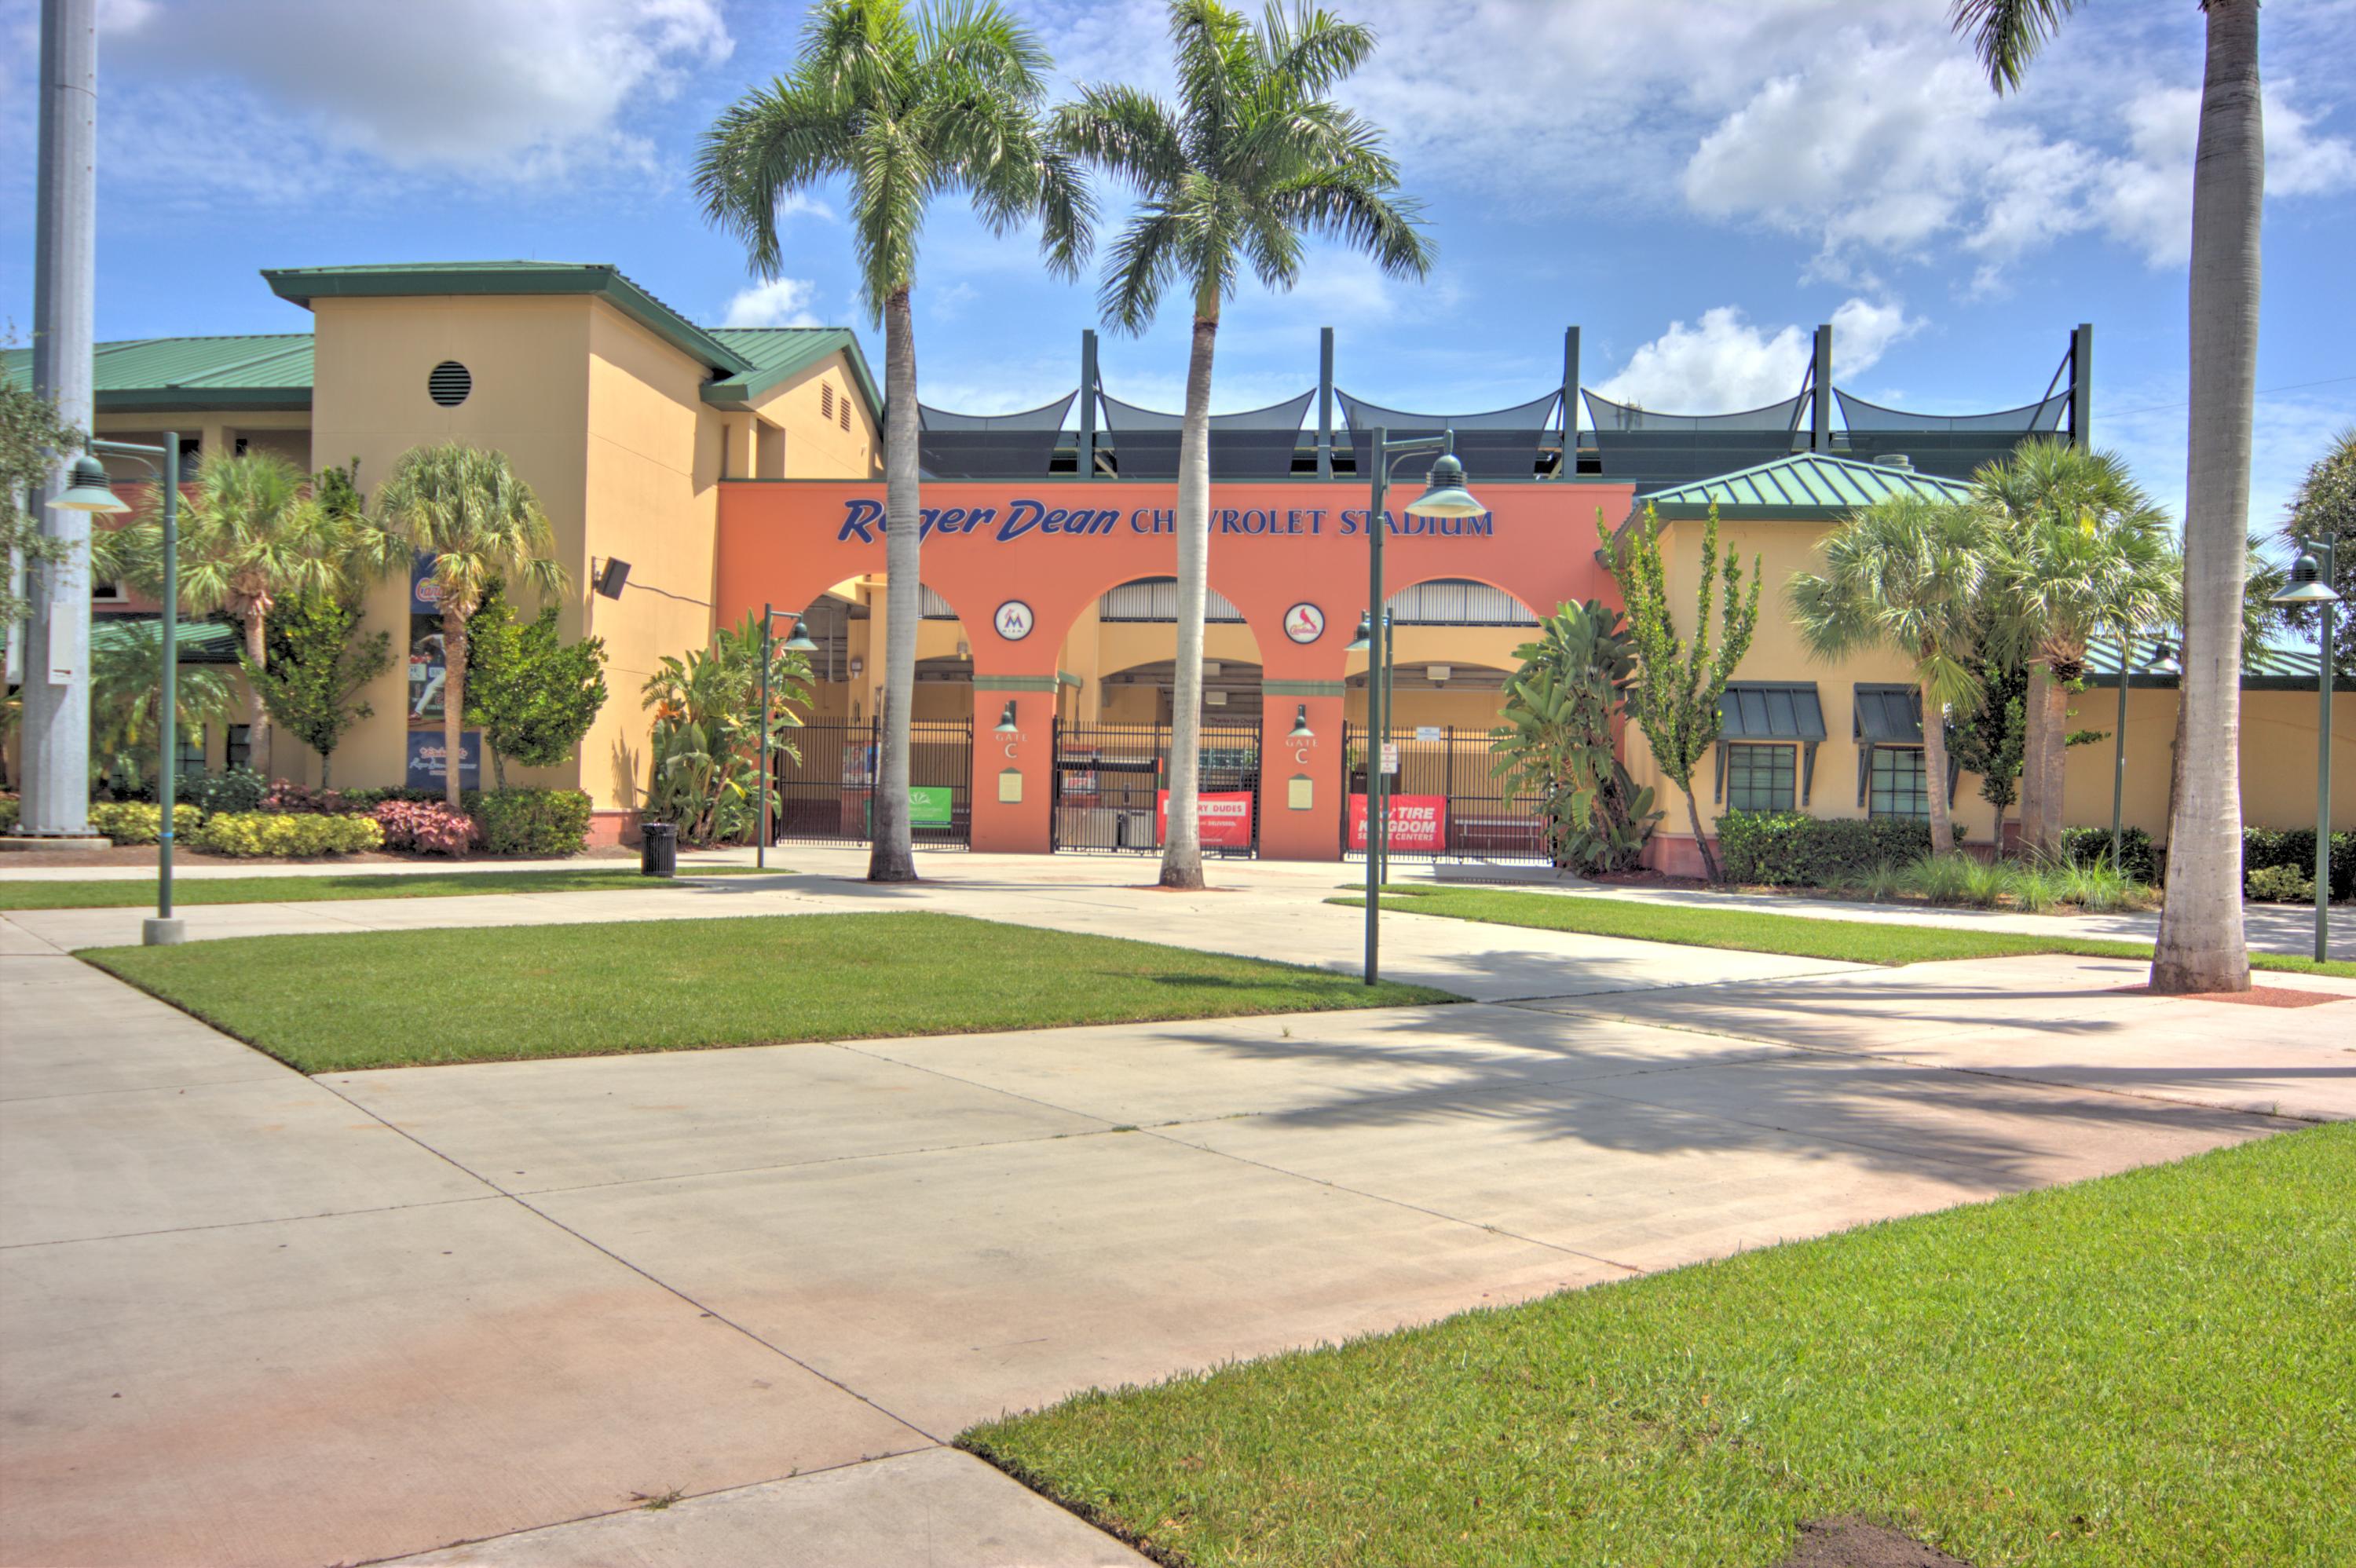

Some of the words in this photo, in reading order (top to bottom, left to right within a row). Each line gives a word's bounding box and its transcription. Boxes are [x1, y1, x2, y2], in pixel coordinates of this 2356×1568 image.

[995, 499, 1121, 543] Dean
[1286, 739, 1318, 747] GATE
[1005, 743, 1018, 758] C
[1295, 747, 1308, 764] C
[1398, 807, 1435, 820] TIRE
[1358, 820, 1436, 833] KGDOM
